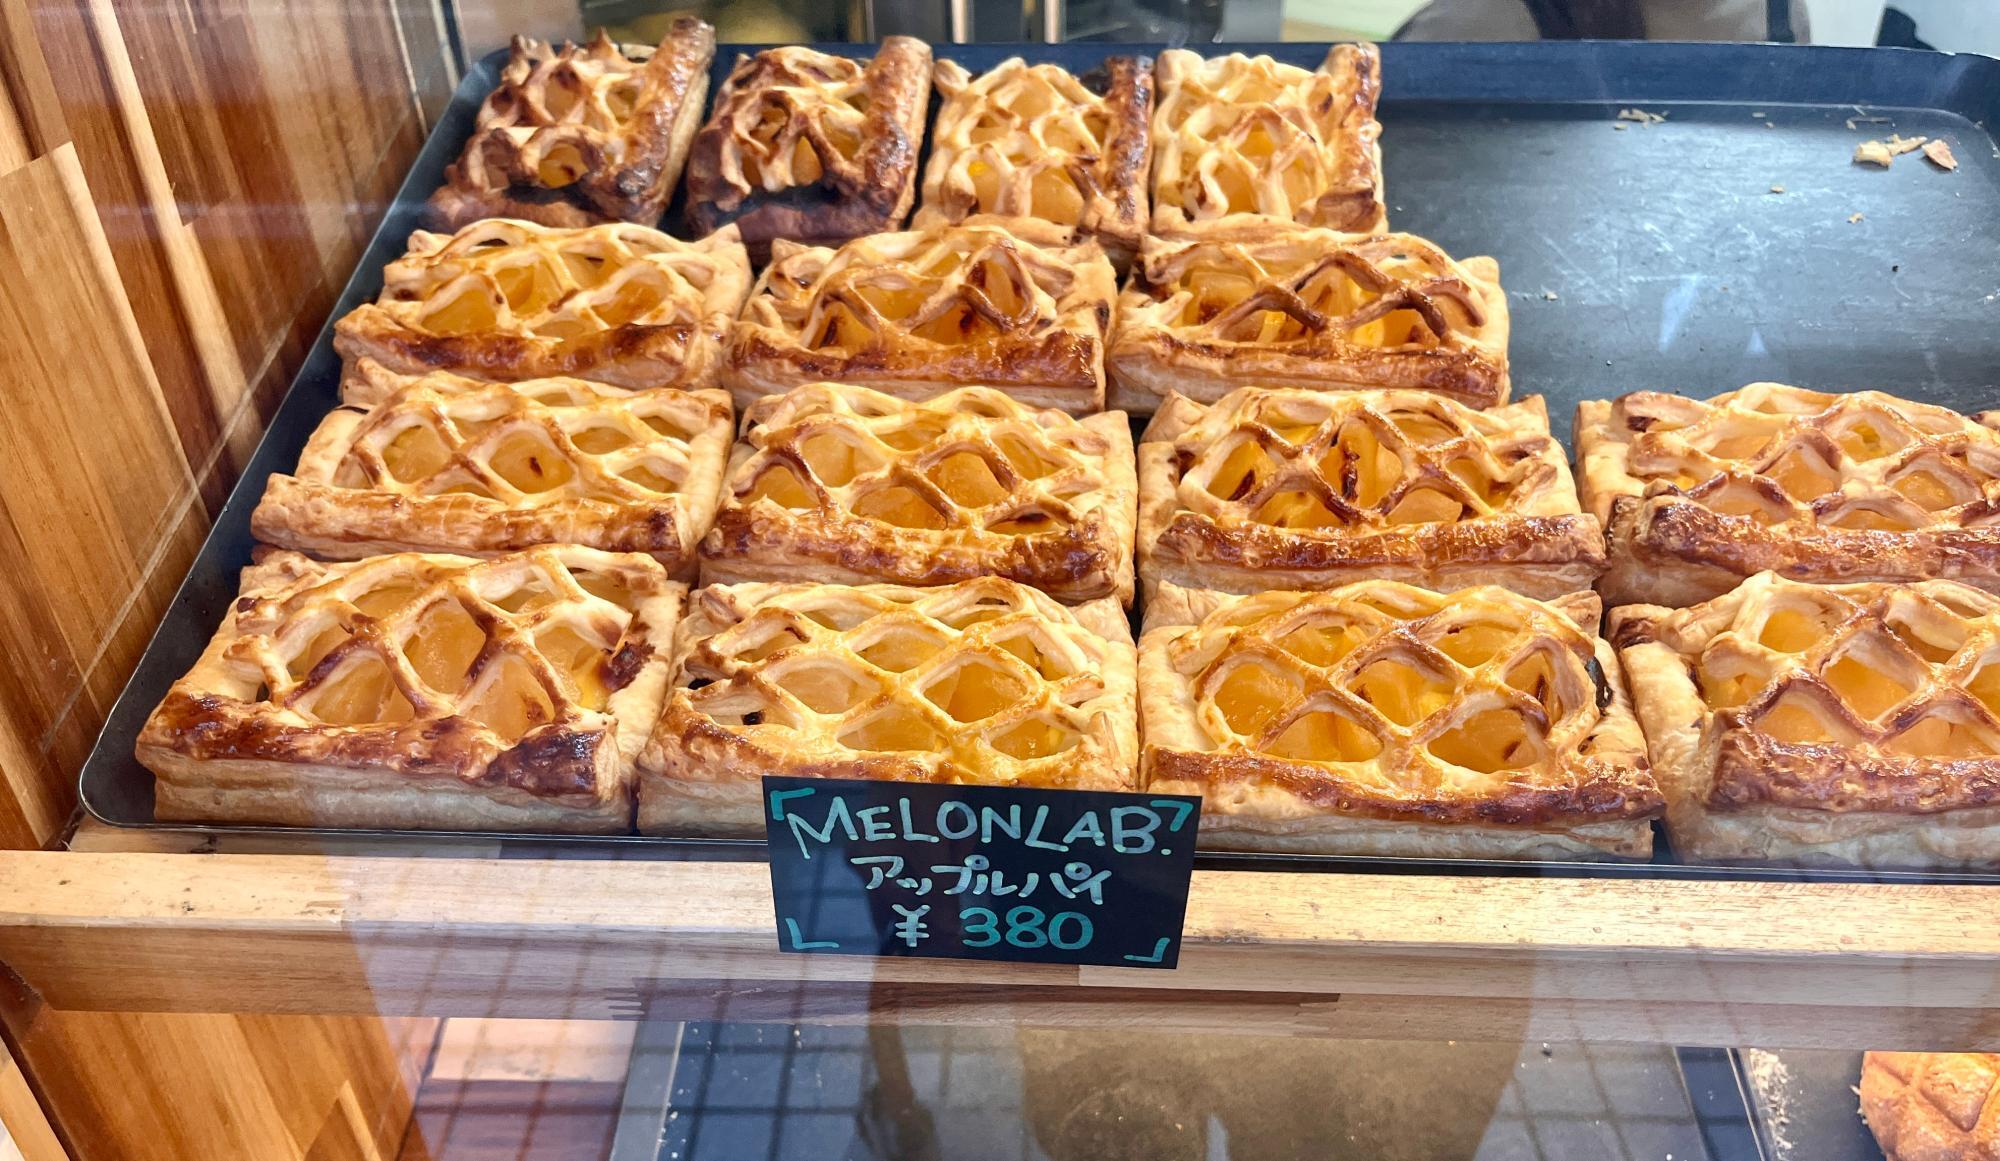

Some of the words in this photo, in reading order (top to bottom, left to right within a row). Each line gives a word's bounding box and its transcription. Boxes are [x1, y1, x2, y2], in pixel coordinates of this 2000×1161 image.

[850, 854, 1112, 905] アップルパイ
[892, 905, 931, 947] ¥
[959, 906, 1094, 950] 380
